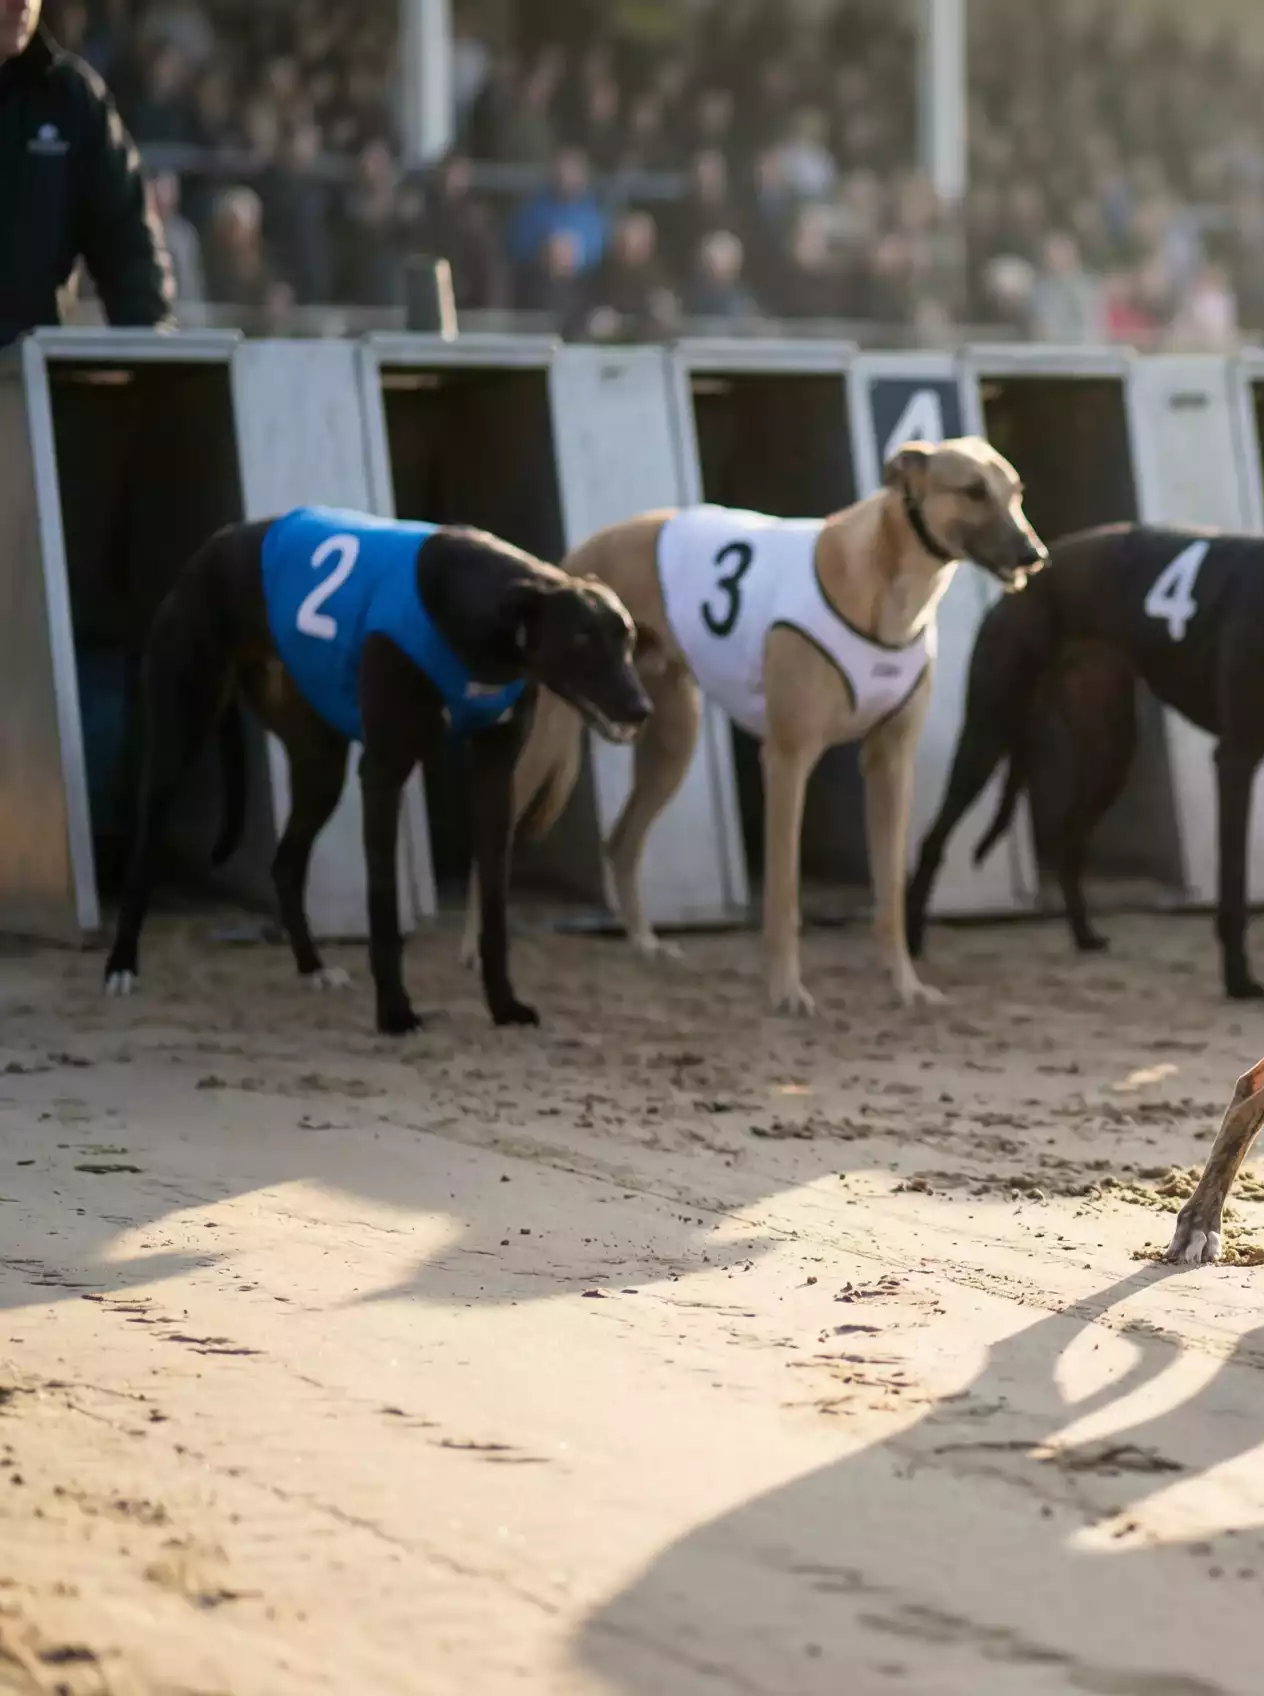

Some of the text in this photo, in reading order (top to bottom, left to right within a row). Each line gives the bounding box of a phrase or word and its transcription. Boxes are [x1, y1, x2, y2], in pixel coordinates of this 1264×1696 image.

[297, 535, 360, 639] 2
[701, 543, 753, 635] 3
[1144, 541, 1210, 641] 4
